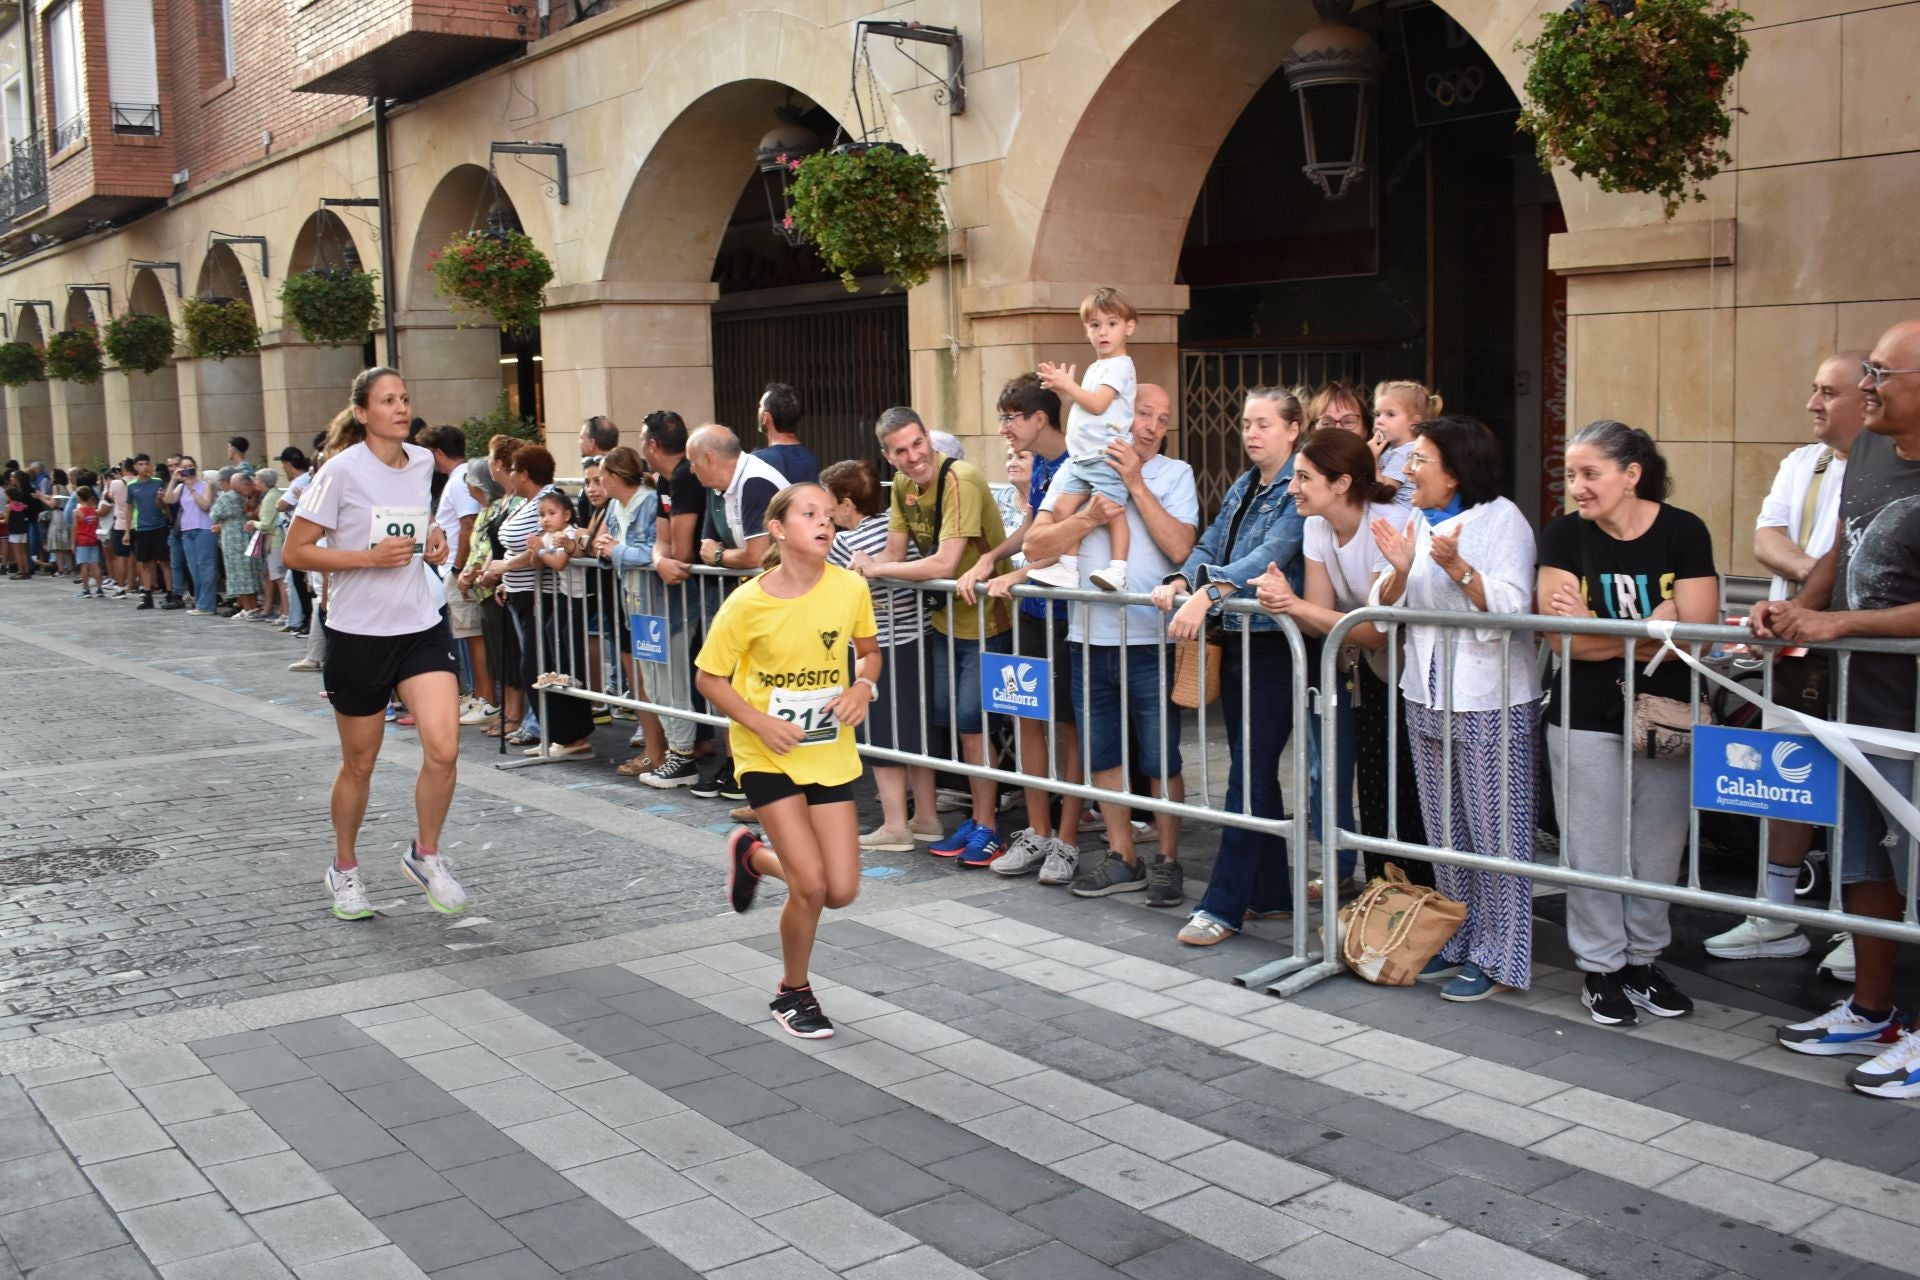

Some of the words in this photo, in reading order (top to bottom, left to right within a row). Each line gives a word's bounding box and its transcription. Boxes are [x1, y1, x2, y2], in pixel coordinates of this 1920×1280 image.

[387, 523, 415, 538] 99
[992, 688, 1038, 706] Calahorra
[1716, 775, 1812, 804] Calahorra
[1716, 796, 1768, 810] Ayuntamiento
